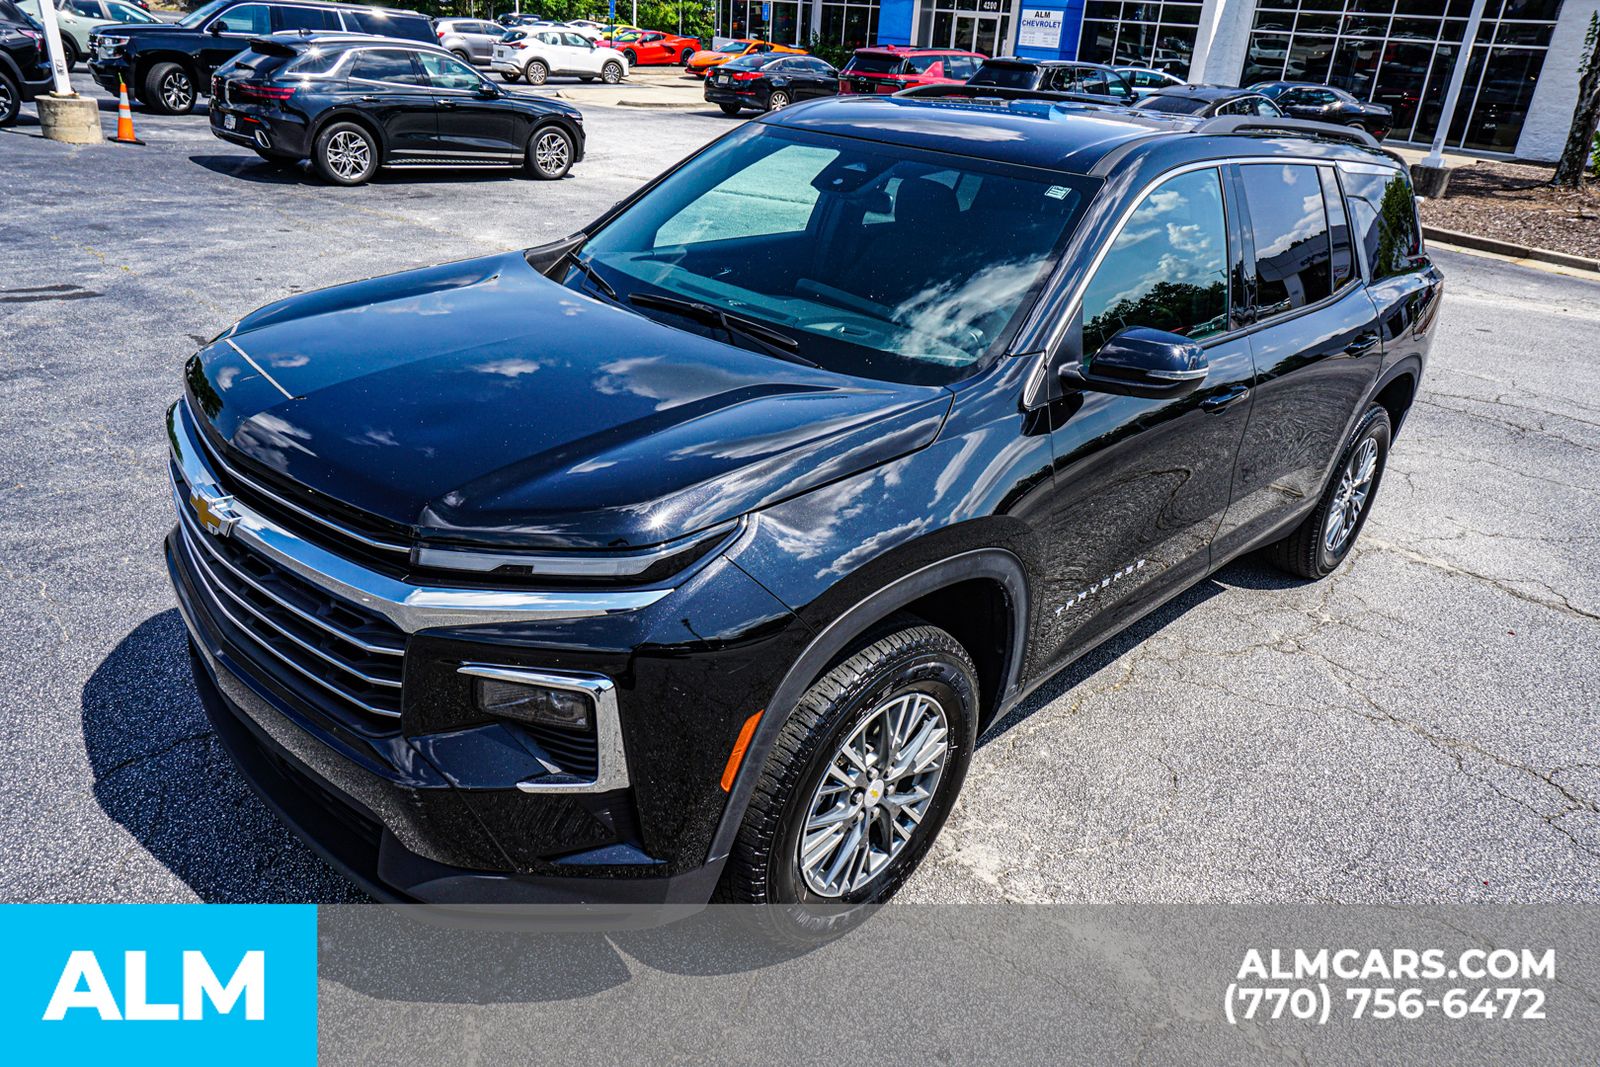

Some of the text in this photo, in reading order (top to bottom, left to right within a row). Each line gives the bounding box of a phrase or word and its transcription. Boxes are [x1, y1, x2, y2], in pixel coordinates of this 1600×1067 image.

[983, 1, 997, 10] 4200
[1022, 19, 1061, 28] CHEVROLET
[1055, 559, 1146, 617] TRAVERSE
